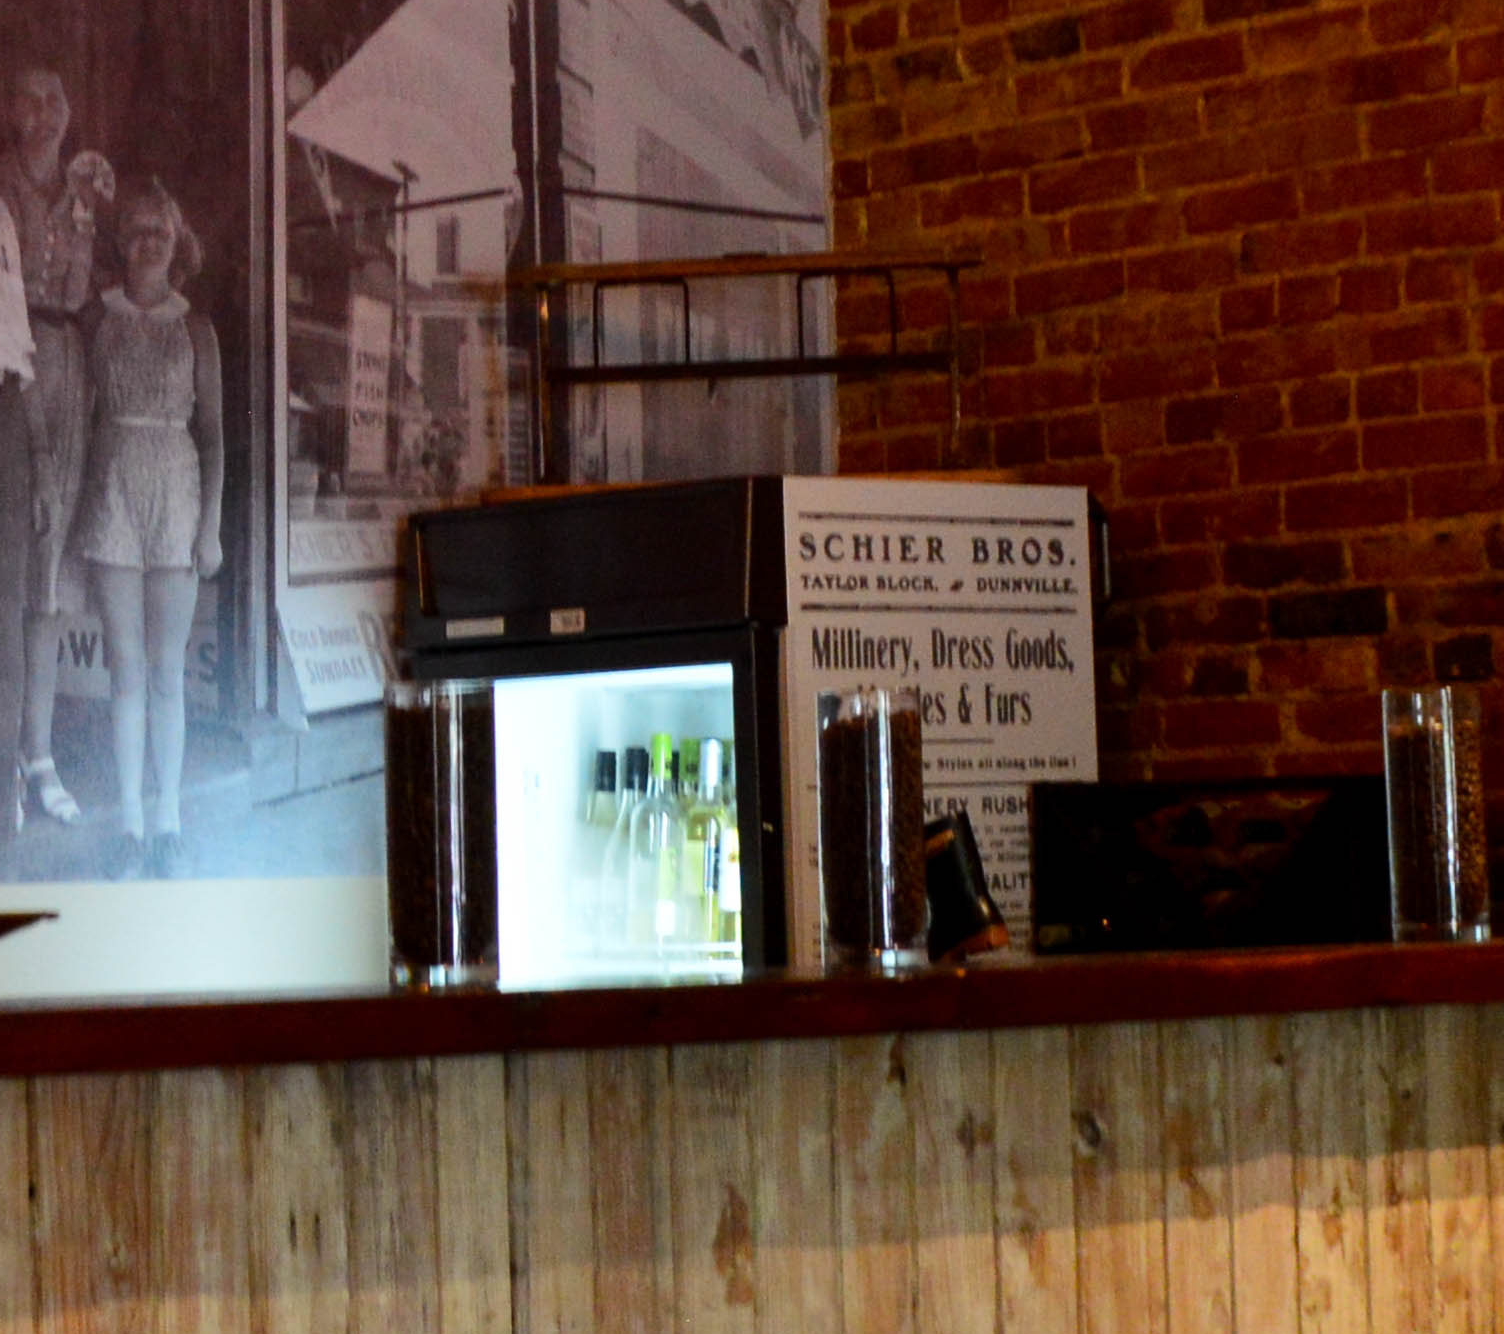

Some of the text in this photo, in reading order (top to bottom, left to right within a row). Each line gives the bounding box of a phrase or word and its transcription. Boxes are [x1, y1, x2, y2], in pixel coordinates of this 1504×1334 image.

[799, 532, 1077, 566] SCHIER BROS.
[801, 574, 869, 591] TAYLOR
[811, 627, 1075, 677] Millinery, Dress Goods,
[958, 684, 973, 726] &
[985, 684, 1032, 725] Furs
